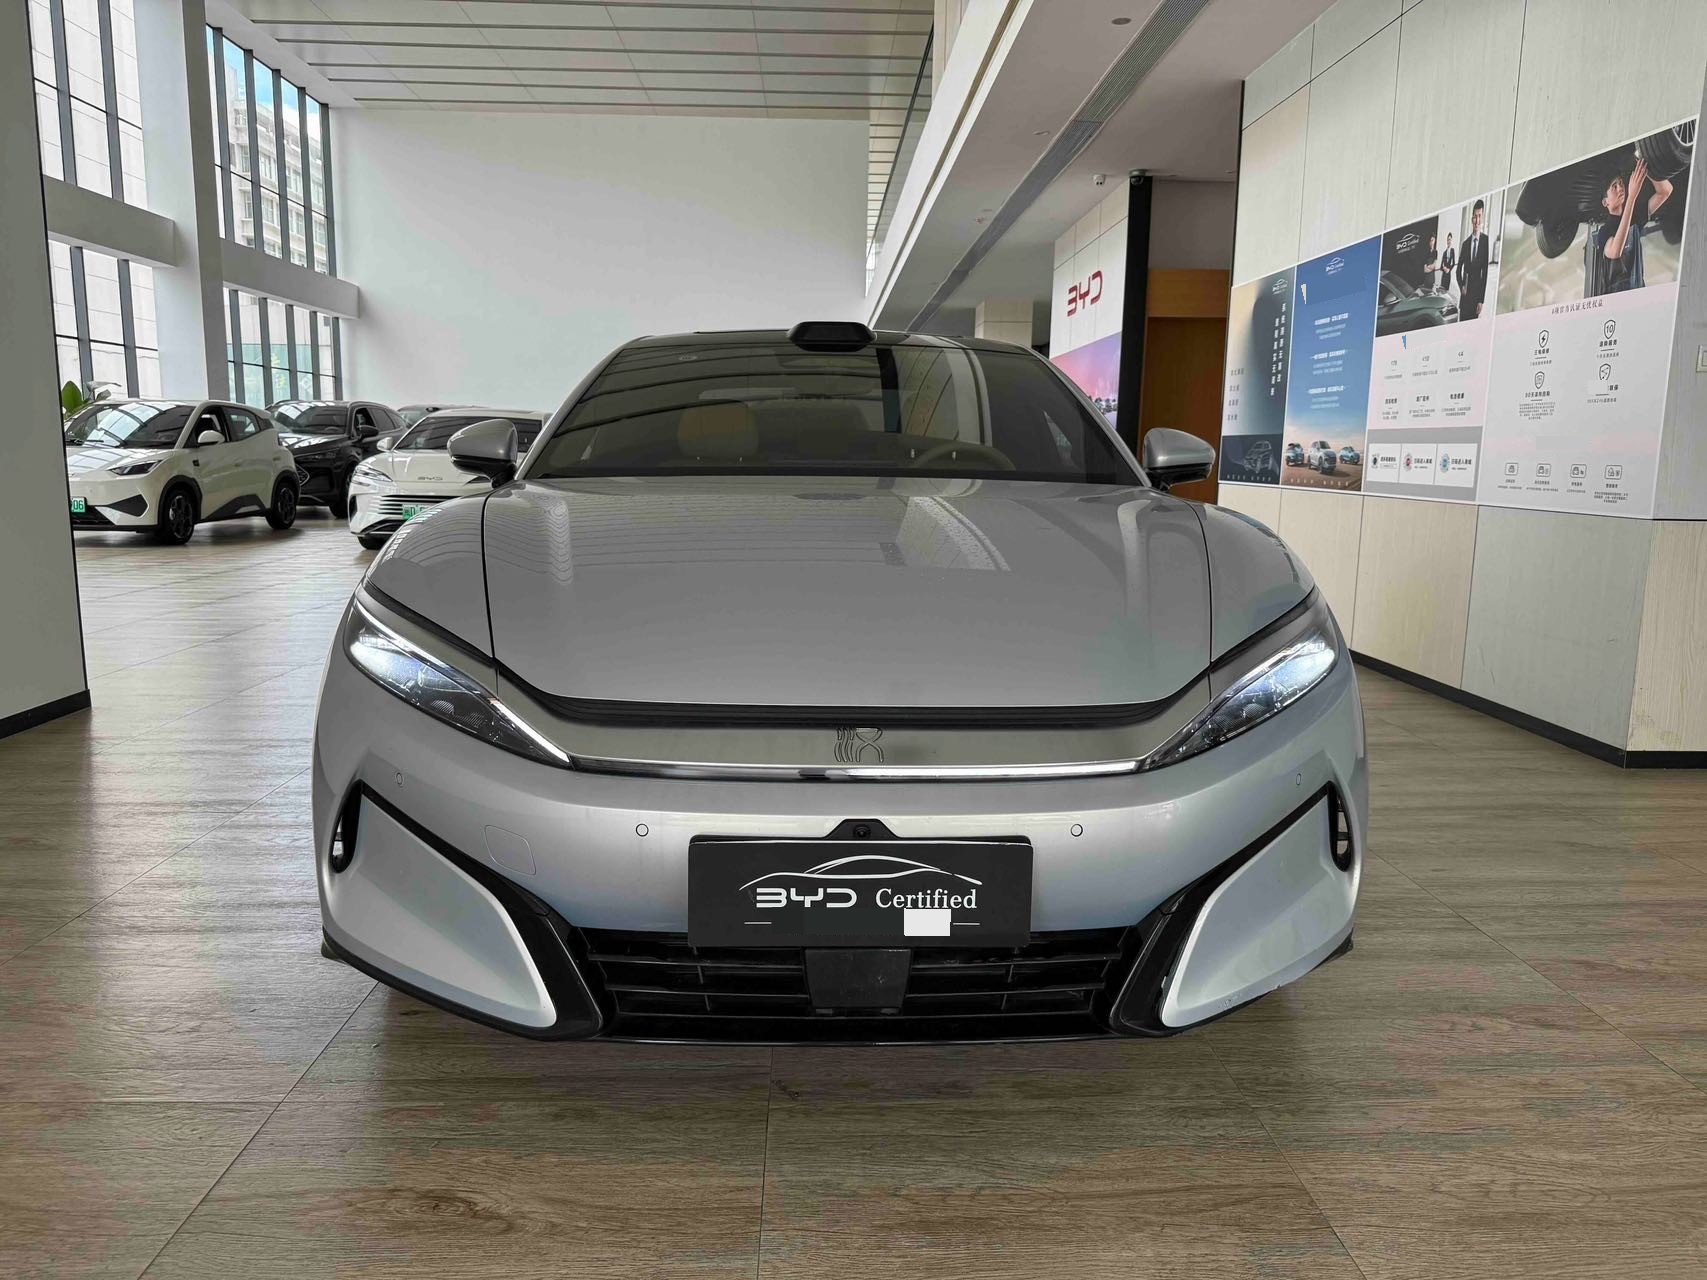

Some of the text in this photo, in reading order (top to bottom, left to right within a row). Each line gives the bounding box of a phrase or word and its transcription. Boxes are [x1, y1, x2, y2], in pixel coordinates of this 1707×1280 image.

[1067, 270, 1104, 317] BYD
[1606, 324, 1614, 334] 10
[73, 499, 84, 511] 06
[756, 887, 978, 909] BYD Certified
